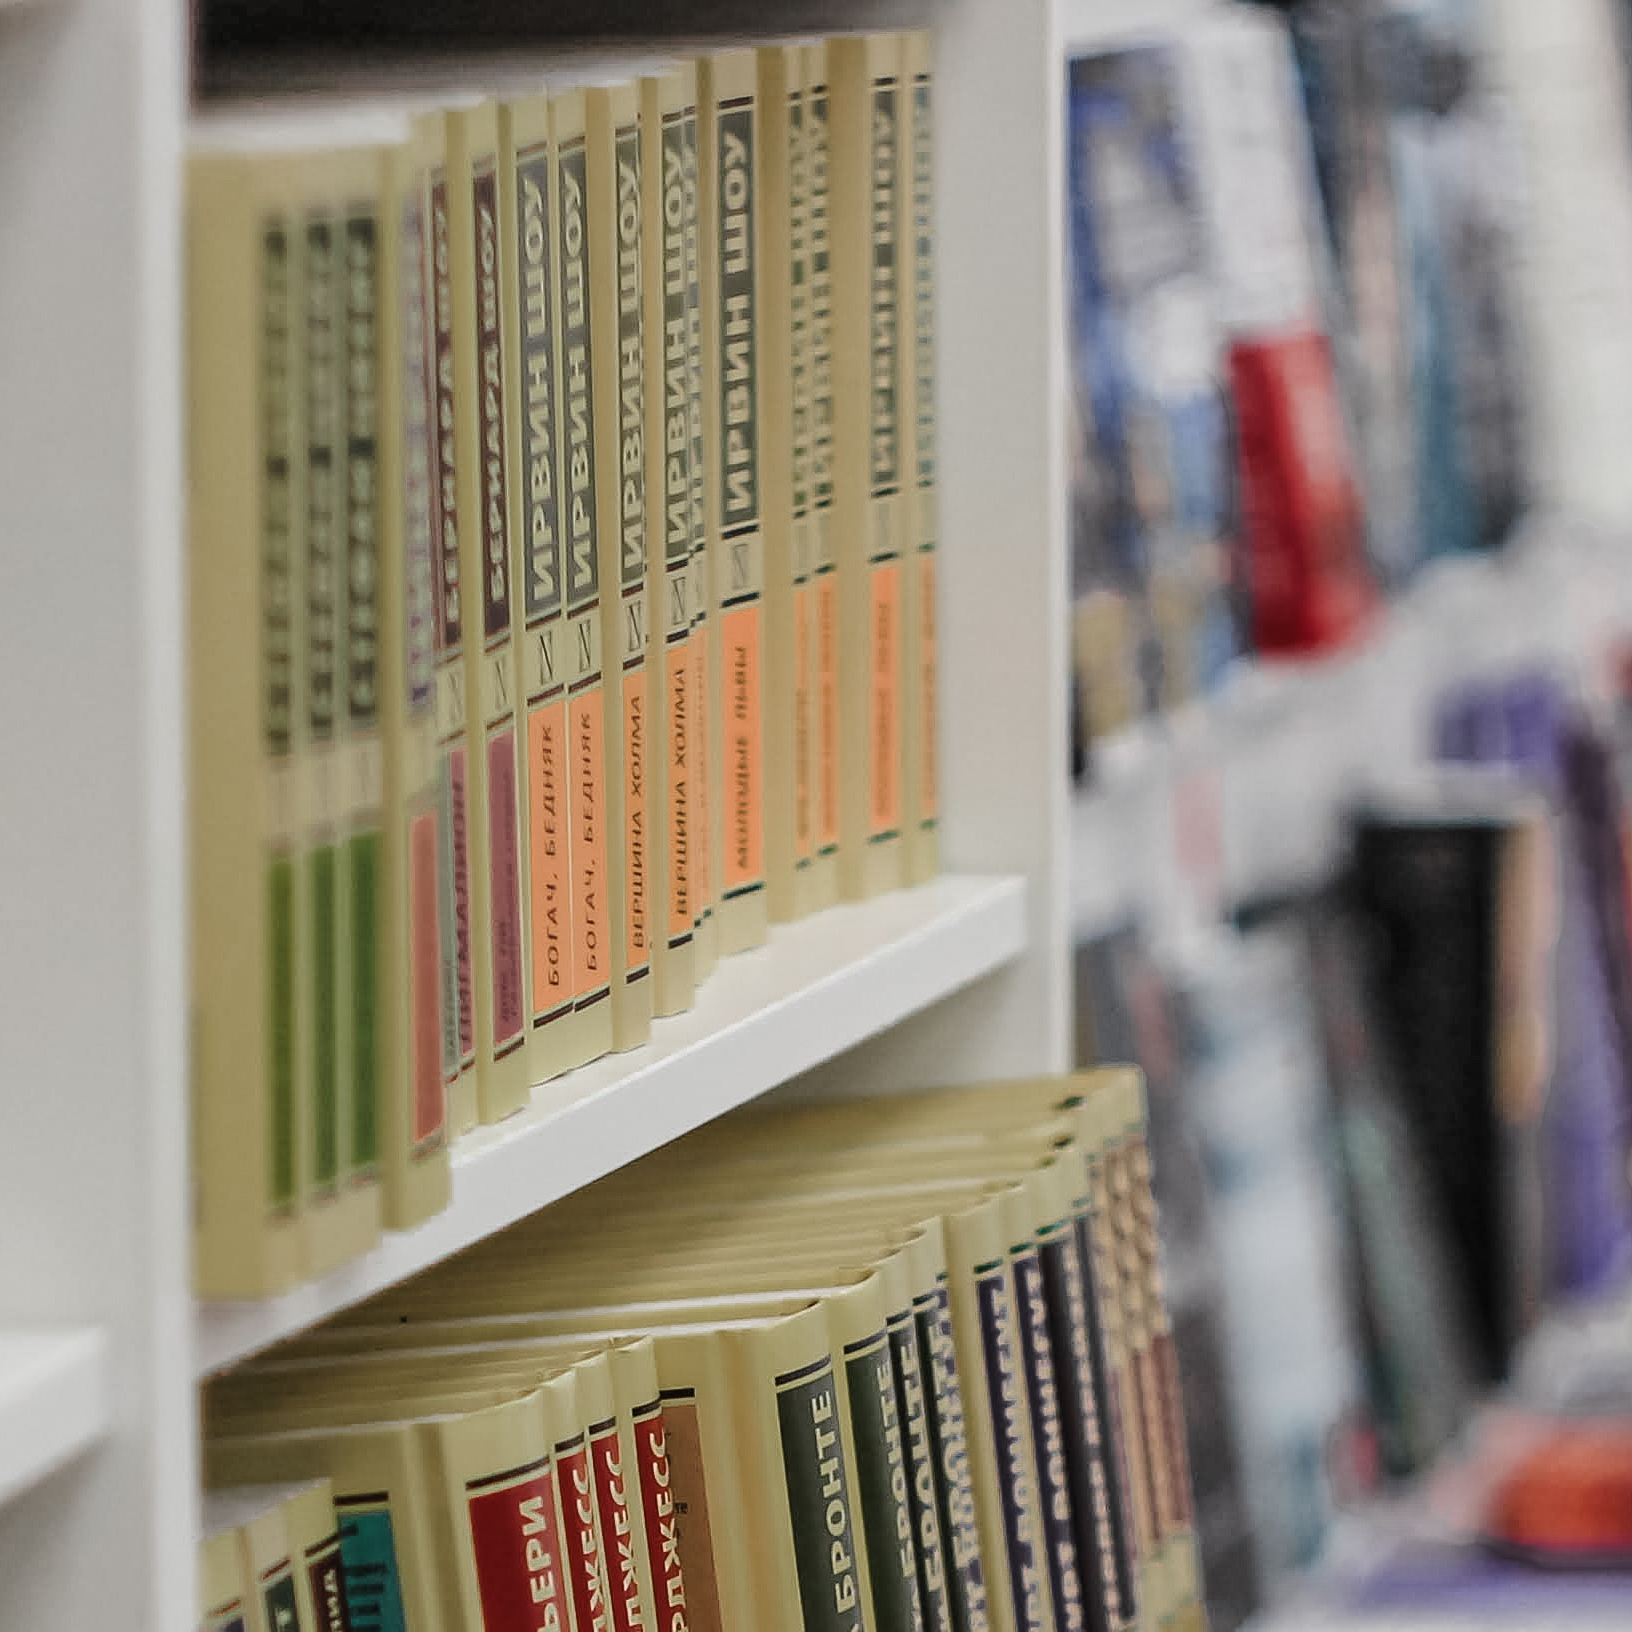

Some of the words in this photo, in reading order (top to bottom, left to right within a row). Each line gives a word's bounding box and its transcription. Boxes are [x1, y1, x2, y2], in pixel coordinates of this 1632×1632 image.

[479, 206, 498, 331] ШОУ
[522, 176, 547, 338] ШОУ
[562, 168, 585, 327] ШОУ
[617, 159, 639, 313] ШОУ
[663, 144, 686, 296] ШОУ
[721, 131, 750, 275] ШОУ
[482, 344, 506, 602] БЕРНАРД
[527, 352, 556, 601] ИРВИН
[567, 346, 594, 589] ИРВИН
[621, 334, 644, 569] ИРВИН
[665, 319, 689, 544] ИРВИН
[724, 293, 754, 512] ИРВИН
[541, 723, 556, 857] БЕДНЯК
[580, 711, 594, 843] БЕДНЯК
[629, 694, 642, 798] ХОЛМА
[672, 668, 687, 769] ХОЛМА
[582, 859, 598, 971] БОГАЧ,
[630, 810, 644, 948] ВЕРШИНА
[674, 780, 688, 916] ВЕРШИНА
[544, 872, 561, 987] БОГАЧ,
[810, 1389, 858, 1614] БРОНТЕ
[877, 1360, 917, 1579] БРОНТЕ
